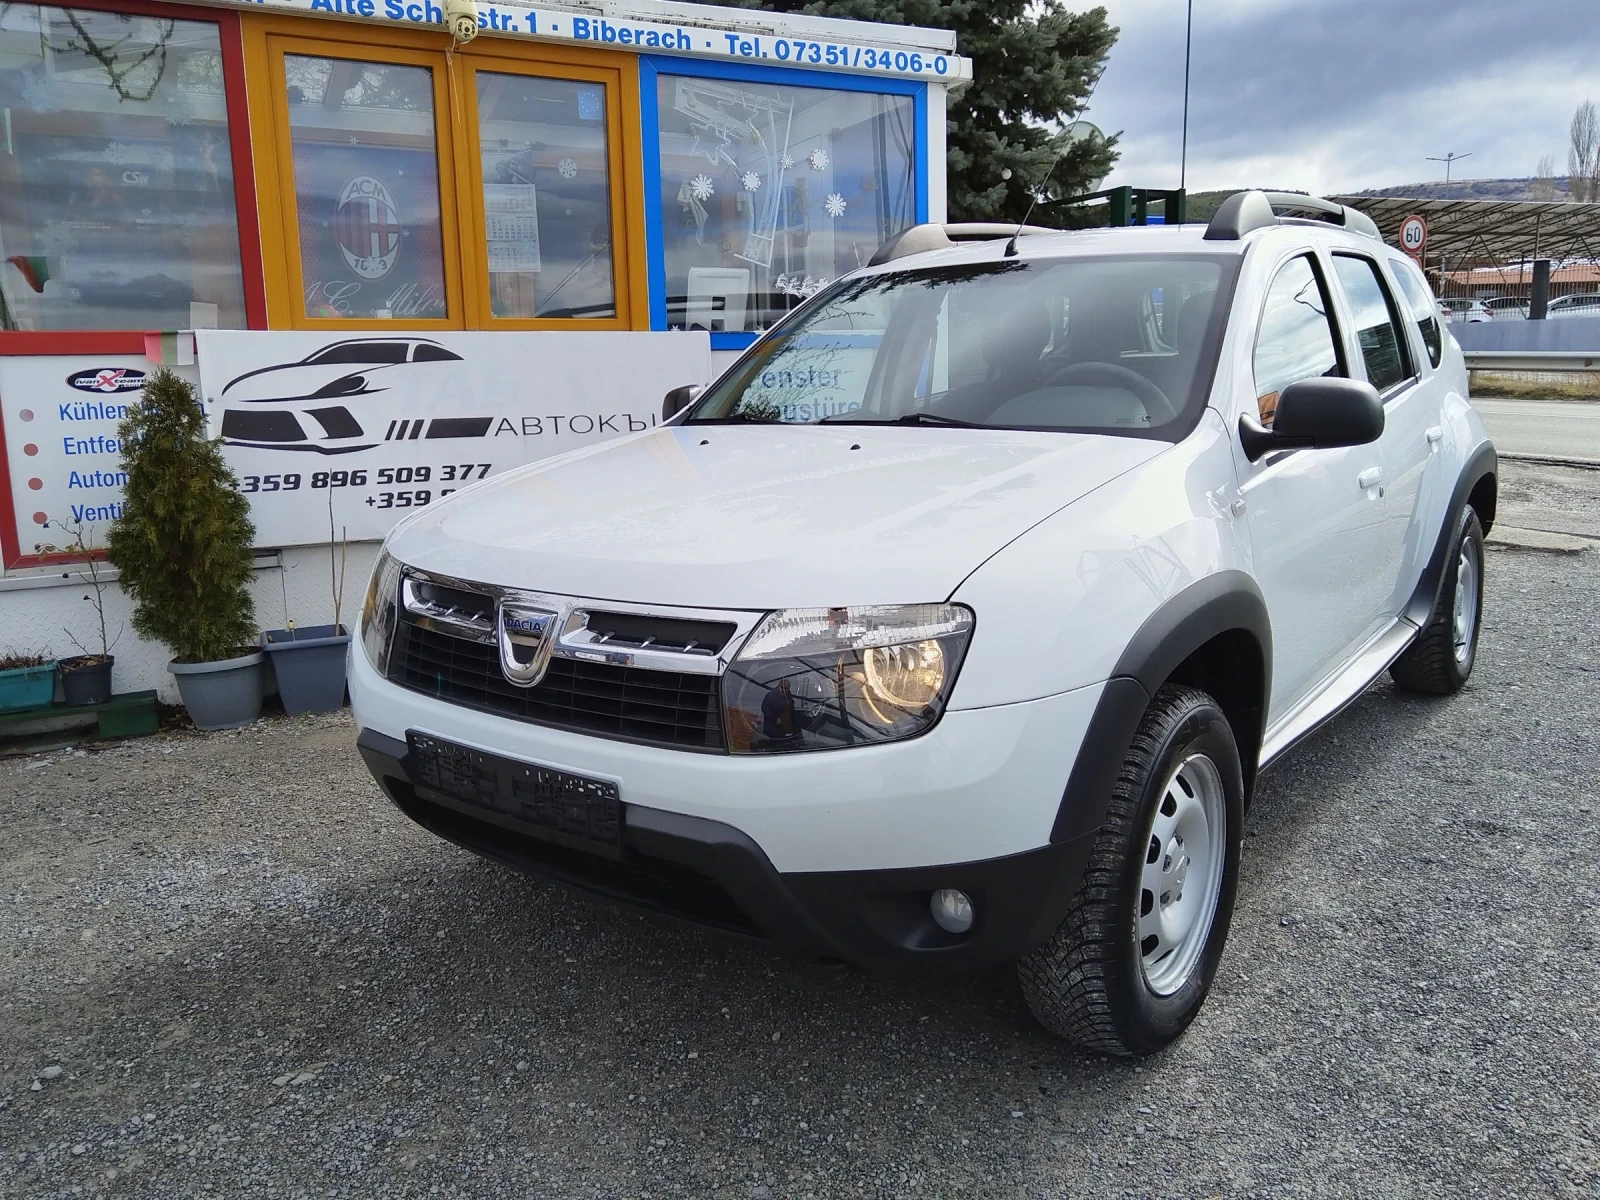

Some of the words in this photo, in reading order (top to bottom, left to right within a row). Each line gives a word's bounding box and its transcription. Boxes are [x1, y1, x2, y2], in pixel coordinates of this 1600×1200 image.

[572, 17, 691, 50] Biberach
[724, 33, 768, 58] Tel.
[775, 39, 948, 75] 07351/3406-0
[348, 179, 387, 201] ACM
[1406, 226, 1421, 243] 60
[354, 258, 388, 272] 189
[761, 366, 841, 389] enster
[59, 401, 129, 421] Kühlen
[495, 413, 656, 436] АВТОКЪ
[229, 474, 302, 493] +359
[311, 469, 368, 489] 896
[377, 466, 432, 485] 509
[439, 463, 492, 481] 377
[365, 489, 432, 509] +359
[505, 618, 543, 632] DACIA
